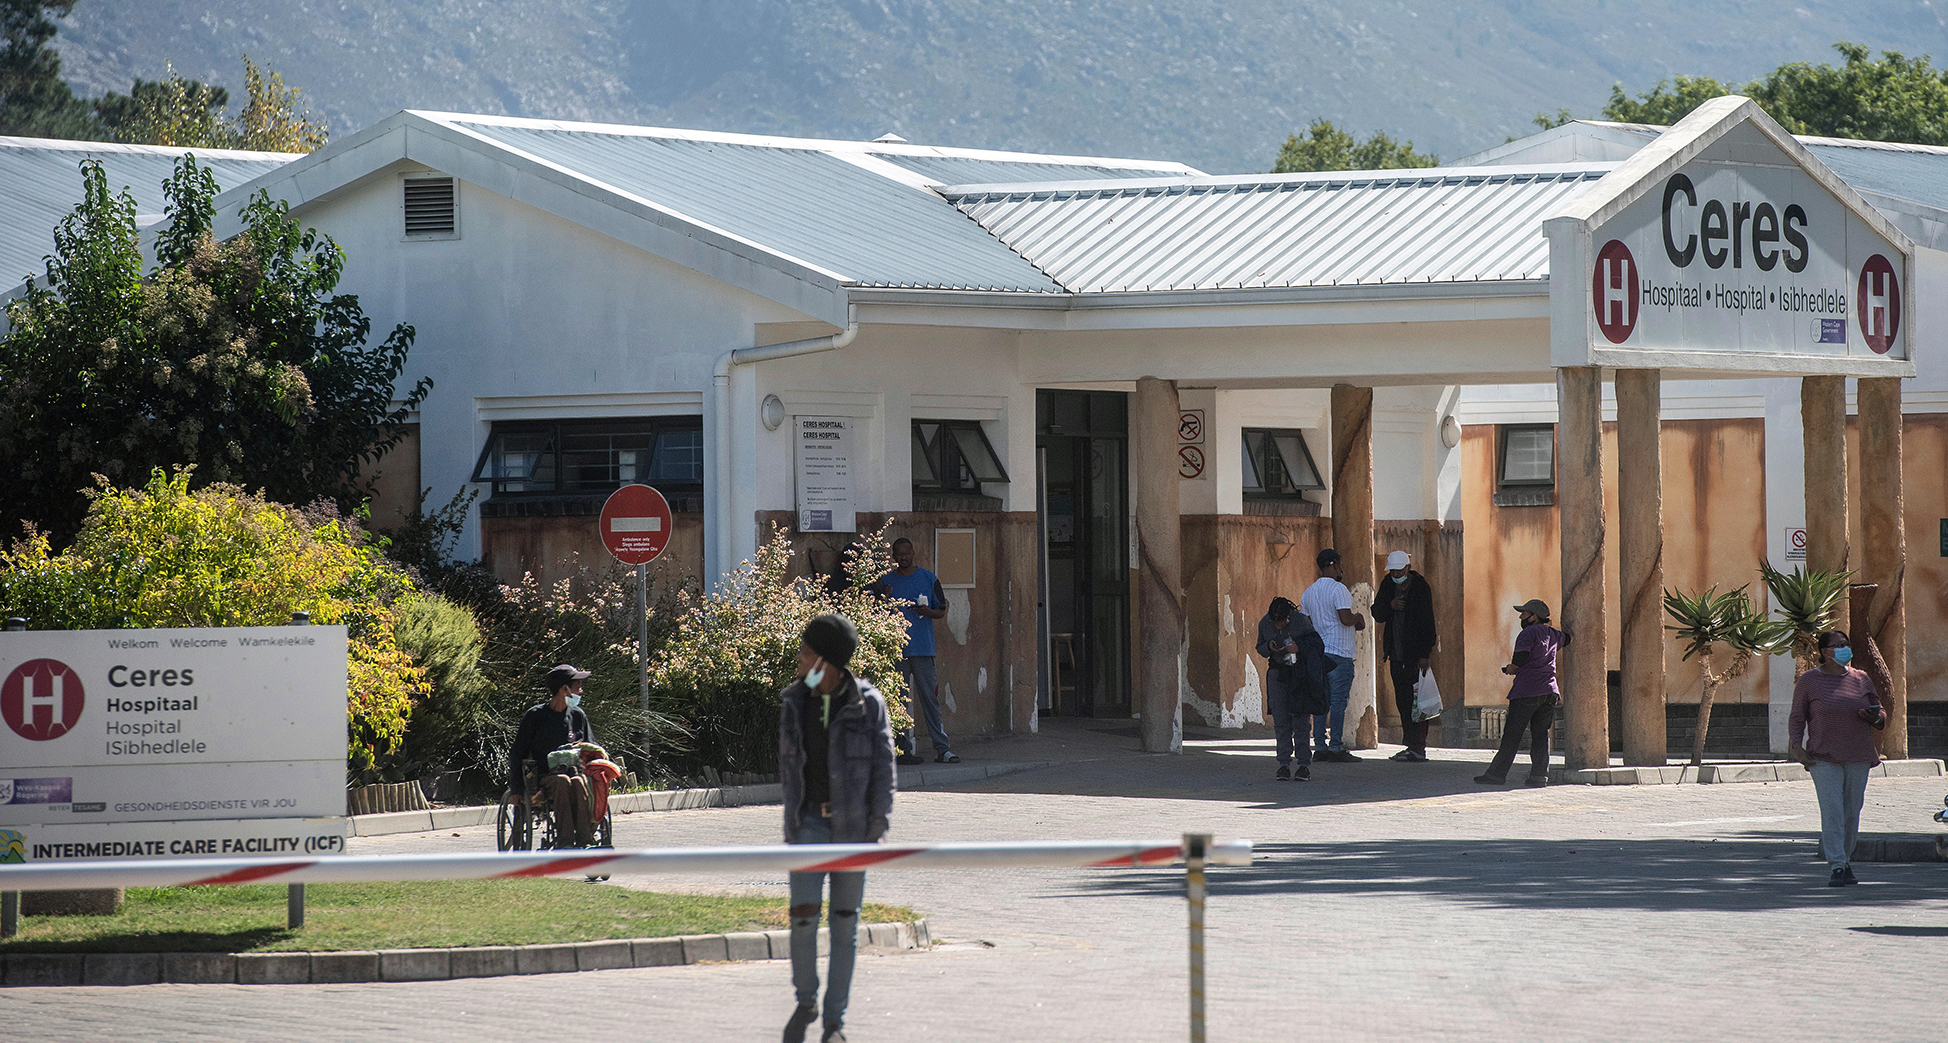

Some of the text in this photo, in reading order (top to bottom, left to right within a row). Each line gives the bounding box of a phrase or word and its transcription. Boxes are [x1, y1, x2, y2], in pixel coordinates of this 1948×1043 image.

[1662, 173, 1809, 273] Ceres
[1603, 259, 1629, 326] H
[1642, 280, 1846, 315] Hospitaal Hospital Isibhedlele
[1866, 271, 1891, 337] H
[108, 636, 315, 649] Welkom Welcome Wamkelekile
[108, 664, 194, 687] Ceres
[23, 675, 63, 725] H
[107, 696, 198, 714] Hospitaal
[106, 719, 181, 736] Hospital
[106, 739, 207, 755] ISibhedlele
[114, 798, 297, 812] GESONDHEIDSDIENSTE VIR JOU
[33, 835, 344, 858] INTERMEDIATE CARE FACILITY (ICF)
